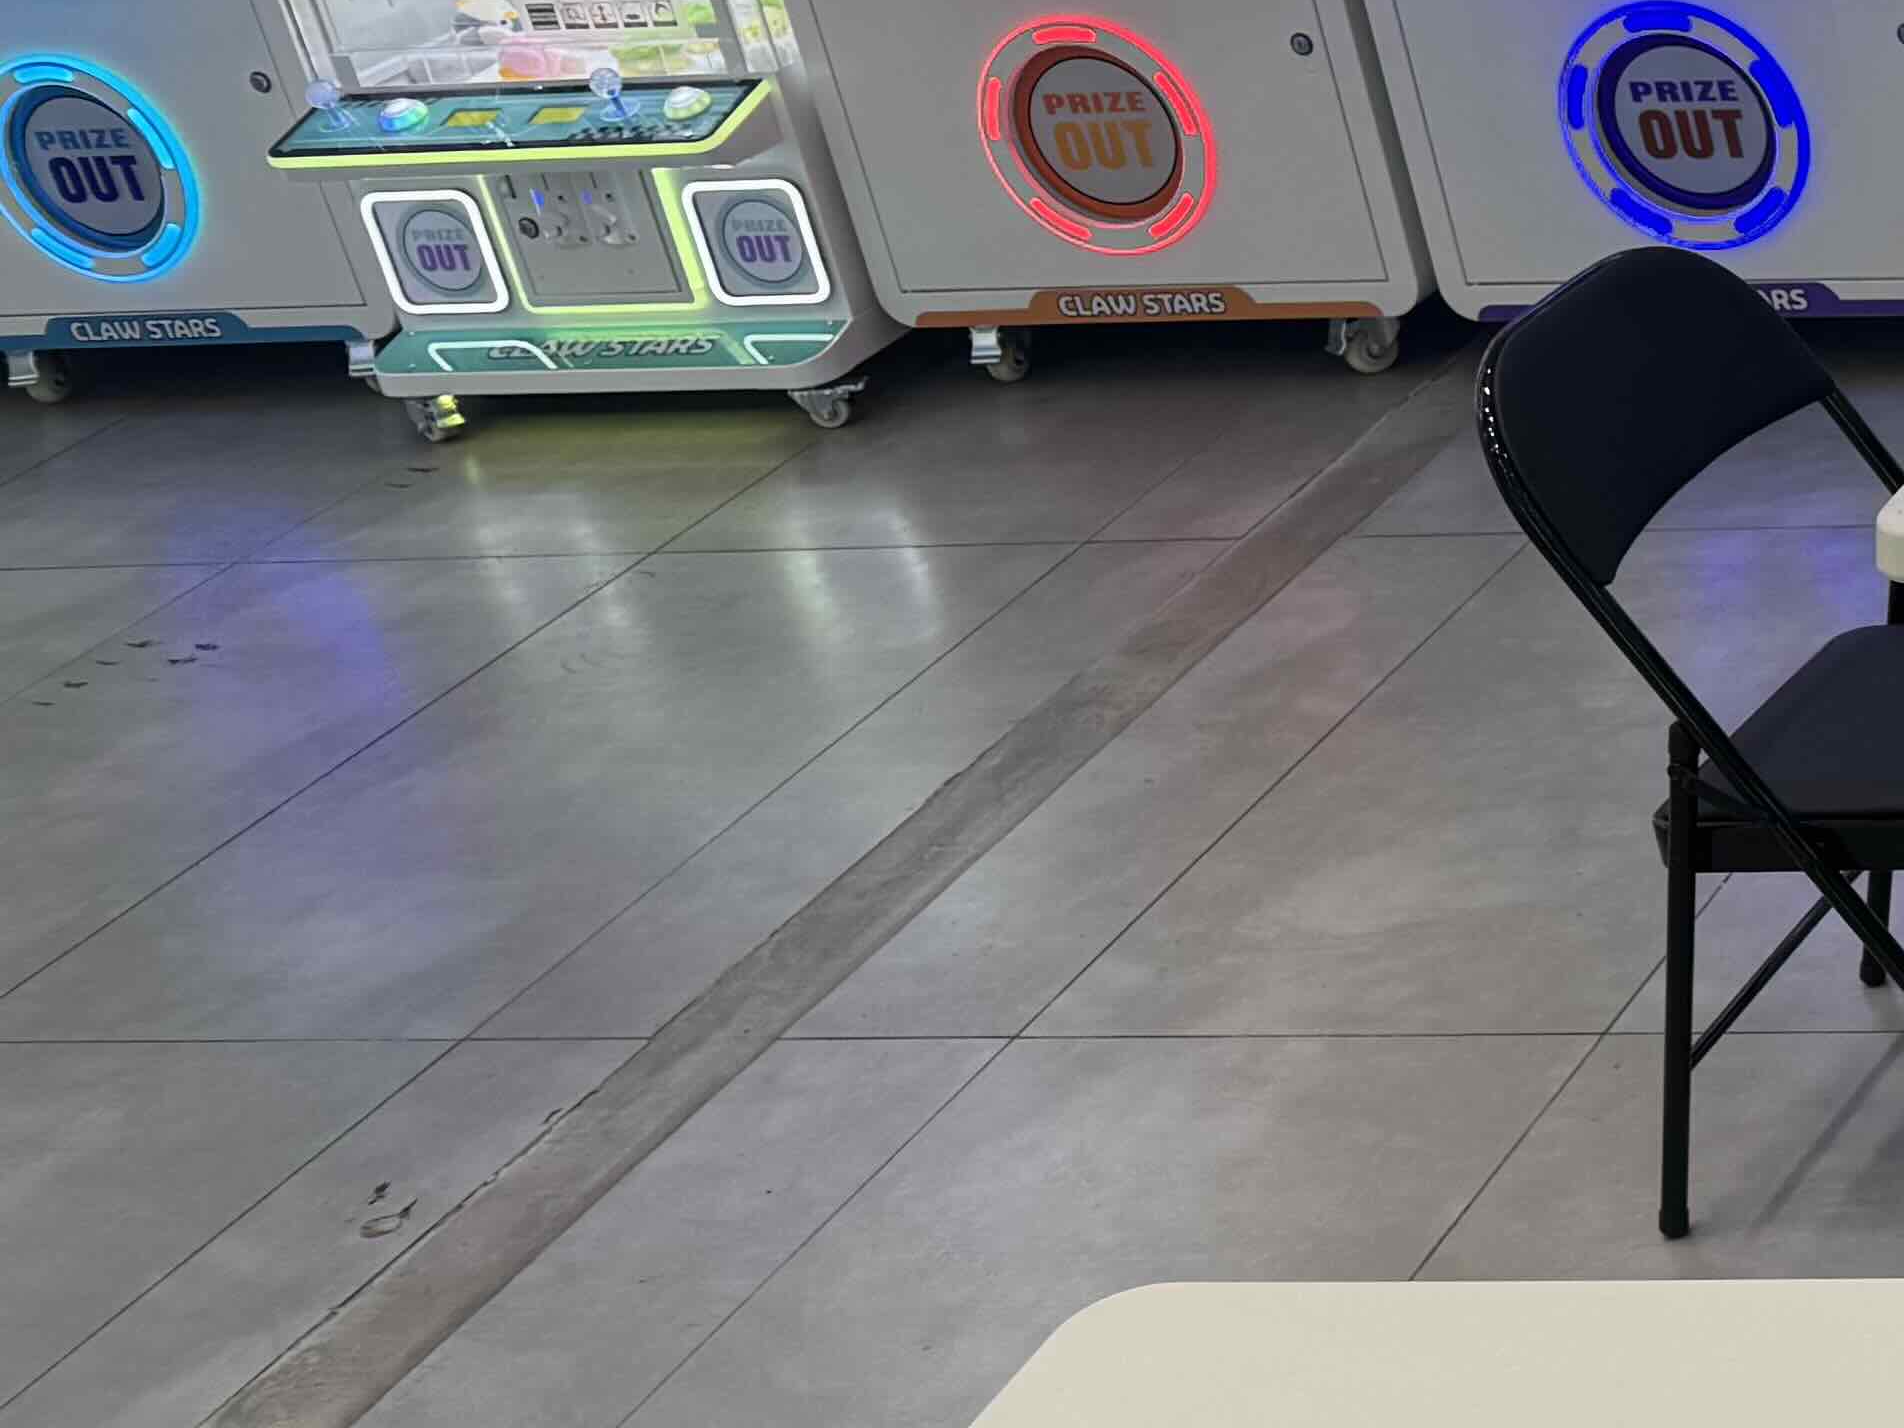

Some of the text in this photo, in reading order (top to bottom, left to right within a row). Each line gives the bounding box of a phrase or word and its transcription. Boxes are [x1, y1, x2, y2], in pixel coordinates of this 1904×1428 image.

[1043, 91, 1147, 116] PRIZE
[1629, 79, 1739, 103] PRIZE
[36, 128, 129, 151] PRIZE
[1054, 120, 1155, 172] OUT
[1640, 110, 1744, 160] OUT
[48, 155, 145, 203] OUT
[416, 243, 470, 273] OUT
[736, 234, 791, 264] OUT
[1058, 292, 1226, 317] CLAW STARS
[70, 317, 222, 342] CLAW STARS
[487, 333, 715, 359] CLAW STARS
